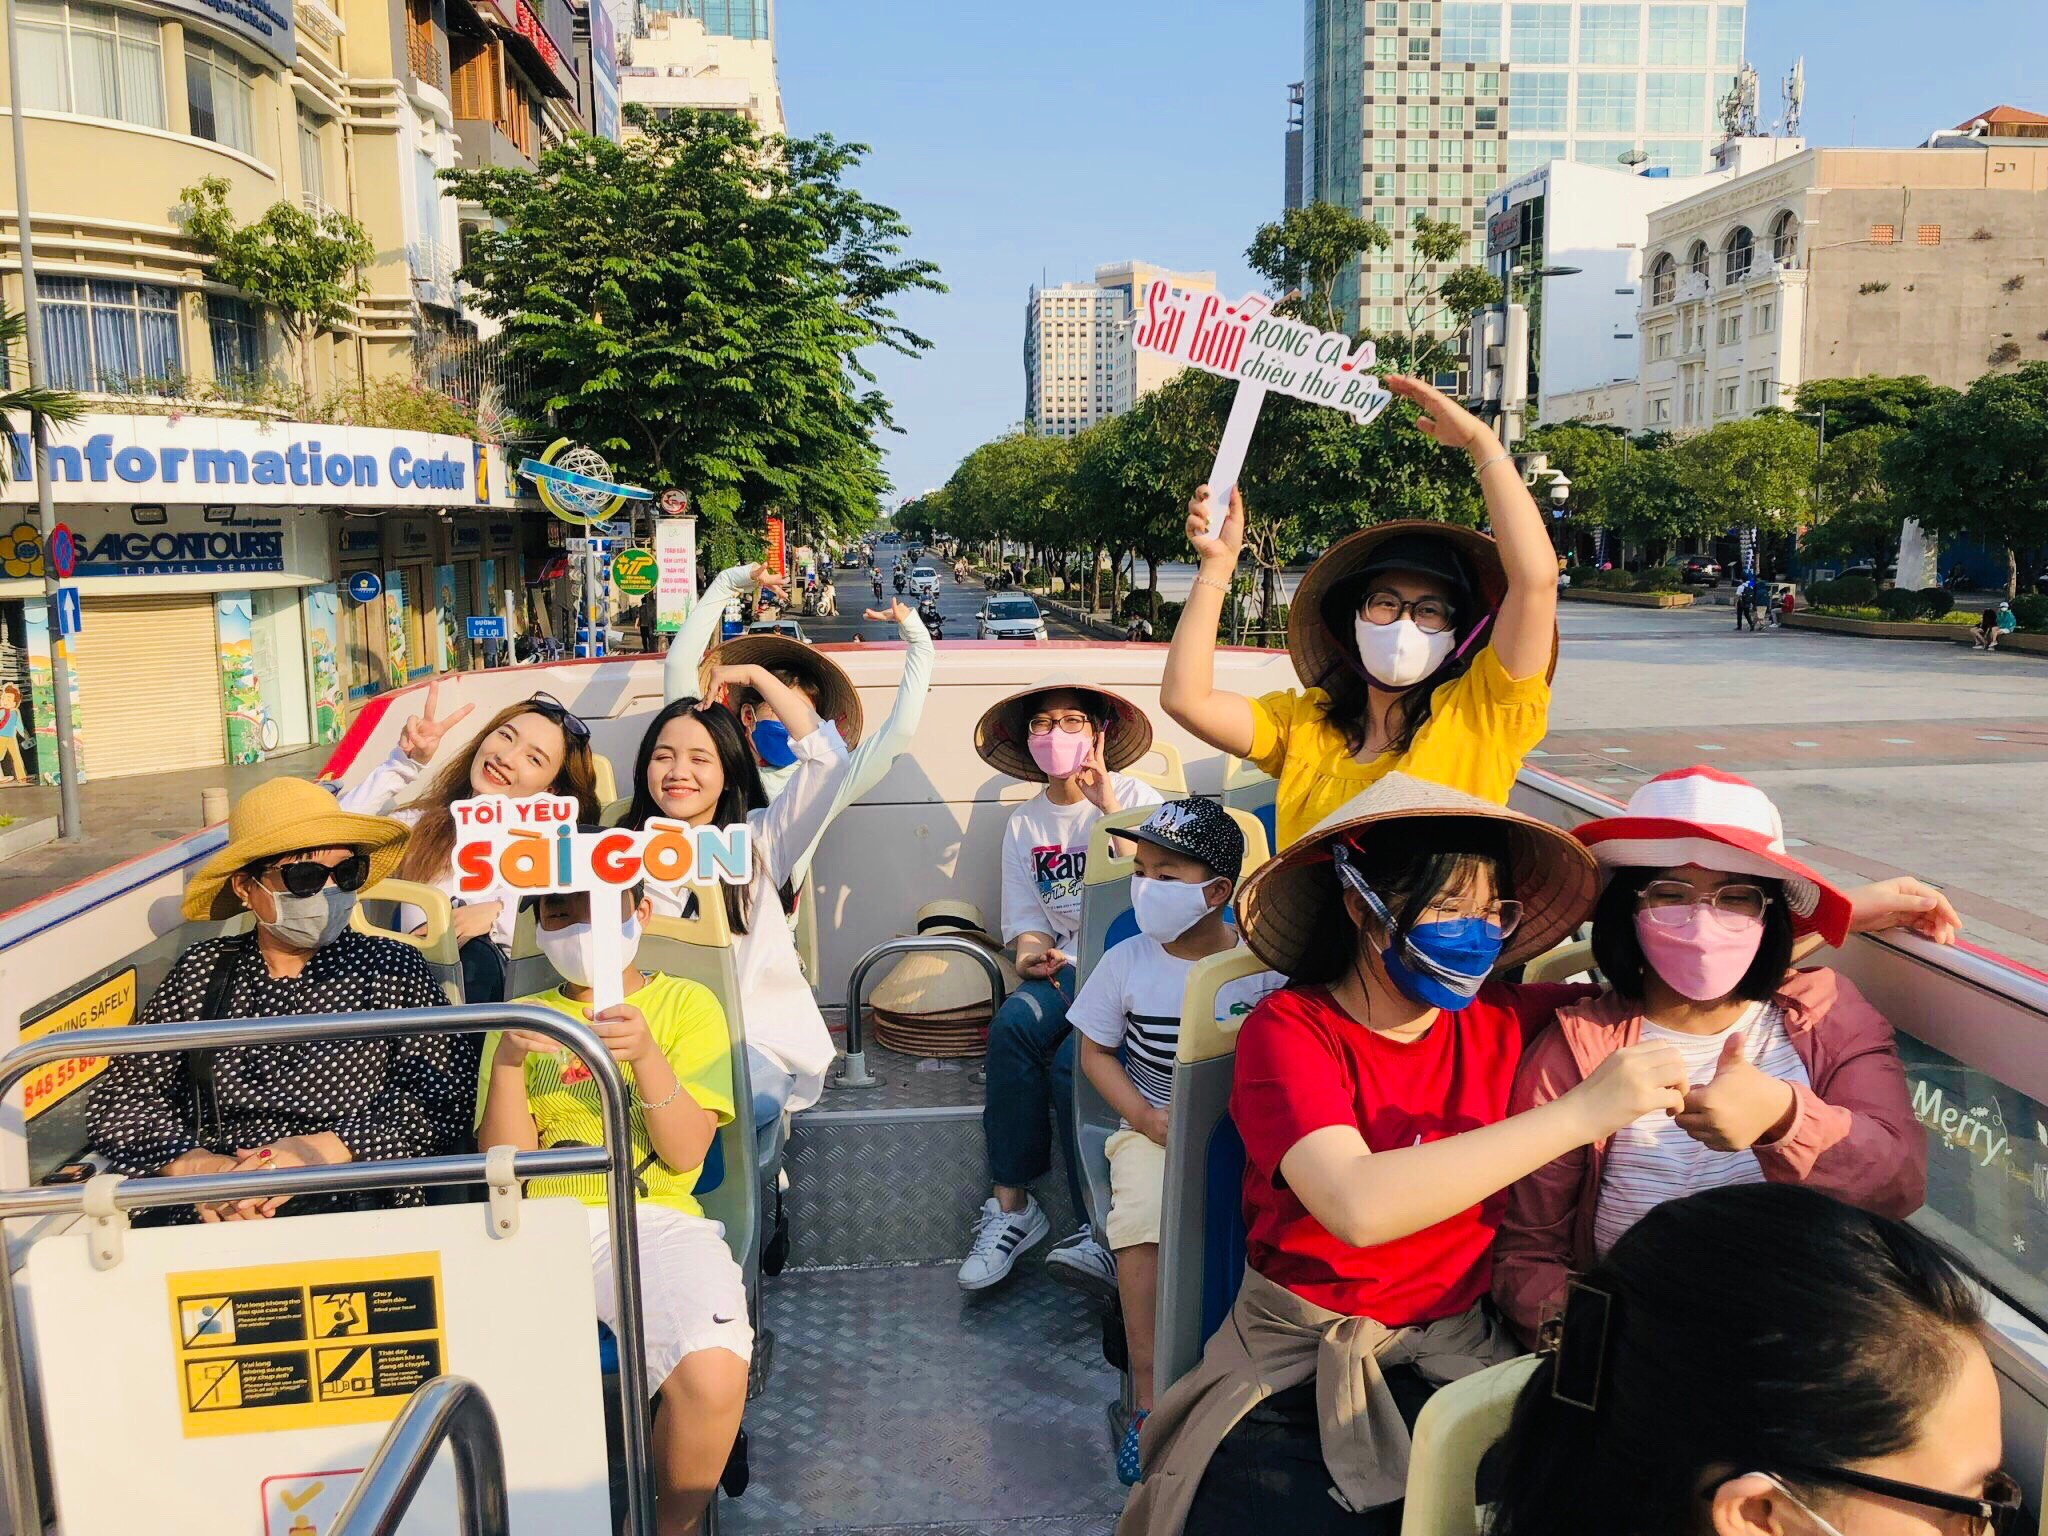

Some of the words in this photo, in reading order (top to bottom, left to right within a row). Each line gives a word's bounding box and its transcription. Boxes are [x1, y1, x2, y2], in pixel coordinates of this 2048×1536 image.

[1101, 290, 1122, 298] TOWER
[1249, 320, 1313, 357] RONG
[1316, 338, 1345, 367] CA
[1299, 367, 1340, 399] thứ
[1340, 379, 1385, 418] Bảy
[12, 433, 377, 487] Information
[389, 445, 465, 490] Center
[122, 565, 202, 576] TRAVEL
[217, 563, 282, 572] SERVICE
[474, 627, 485, 636] LÊ
[515, 798, 571, 823] YÊU
[591, 823, 746, 883] GÒN
[1033, 850, 1086, 883] Kap
[90, 985, 131, 1021] SAFELY
[58, 1058, 76, 1087] 55
[1911, 1080, 2008, 1167] Merry
